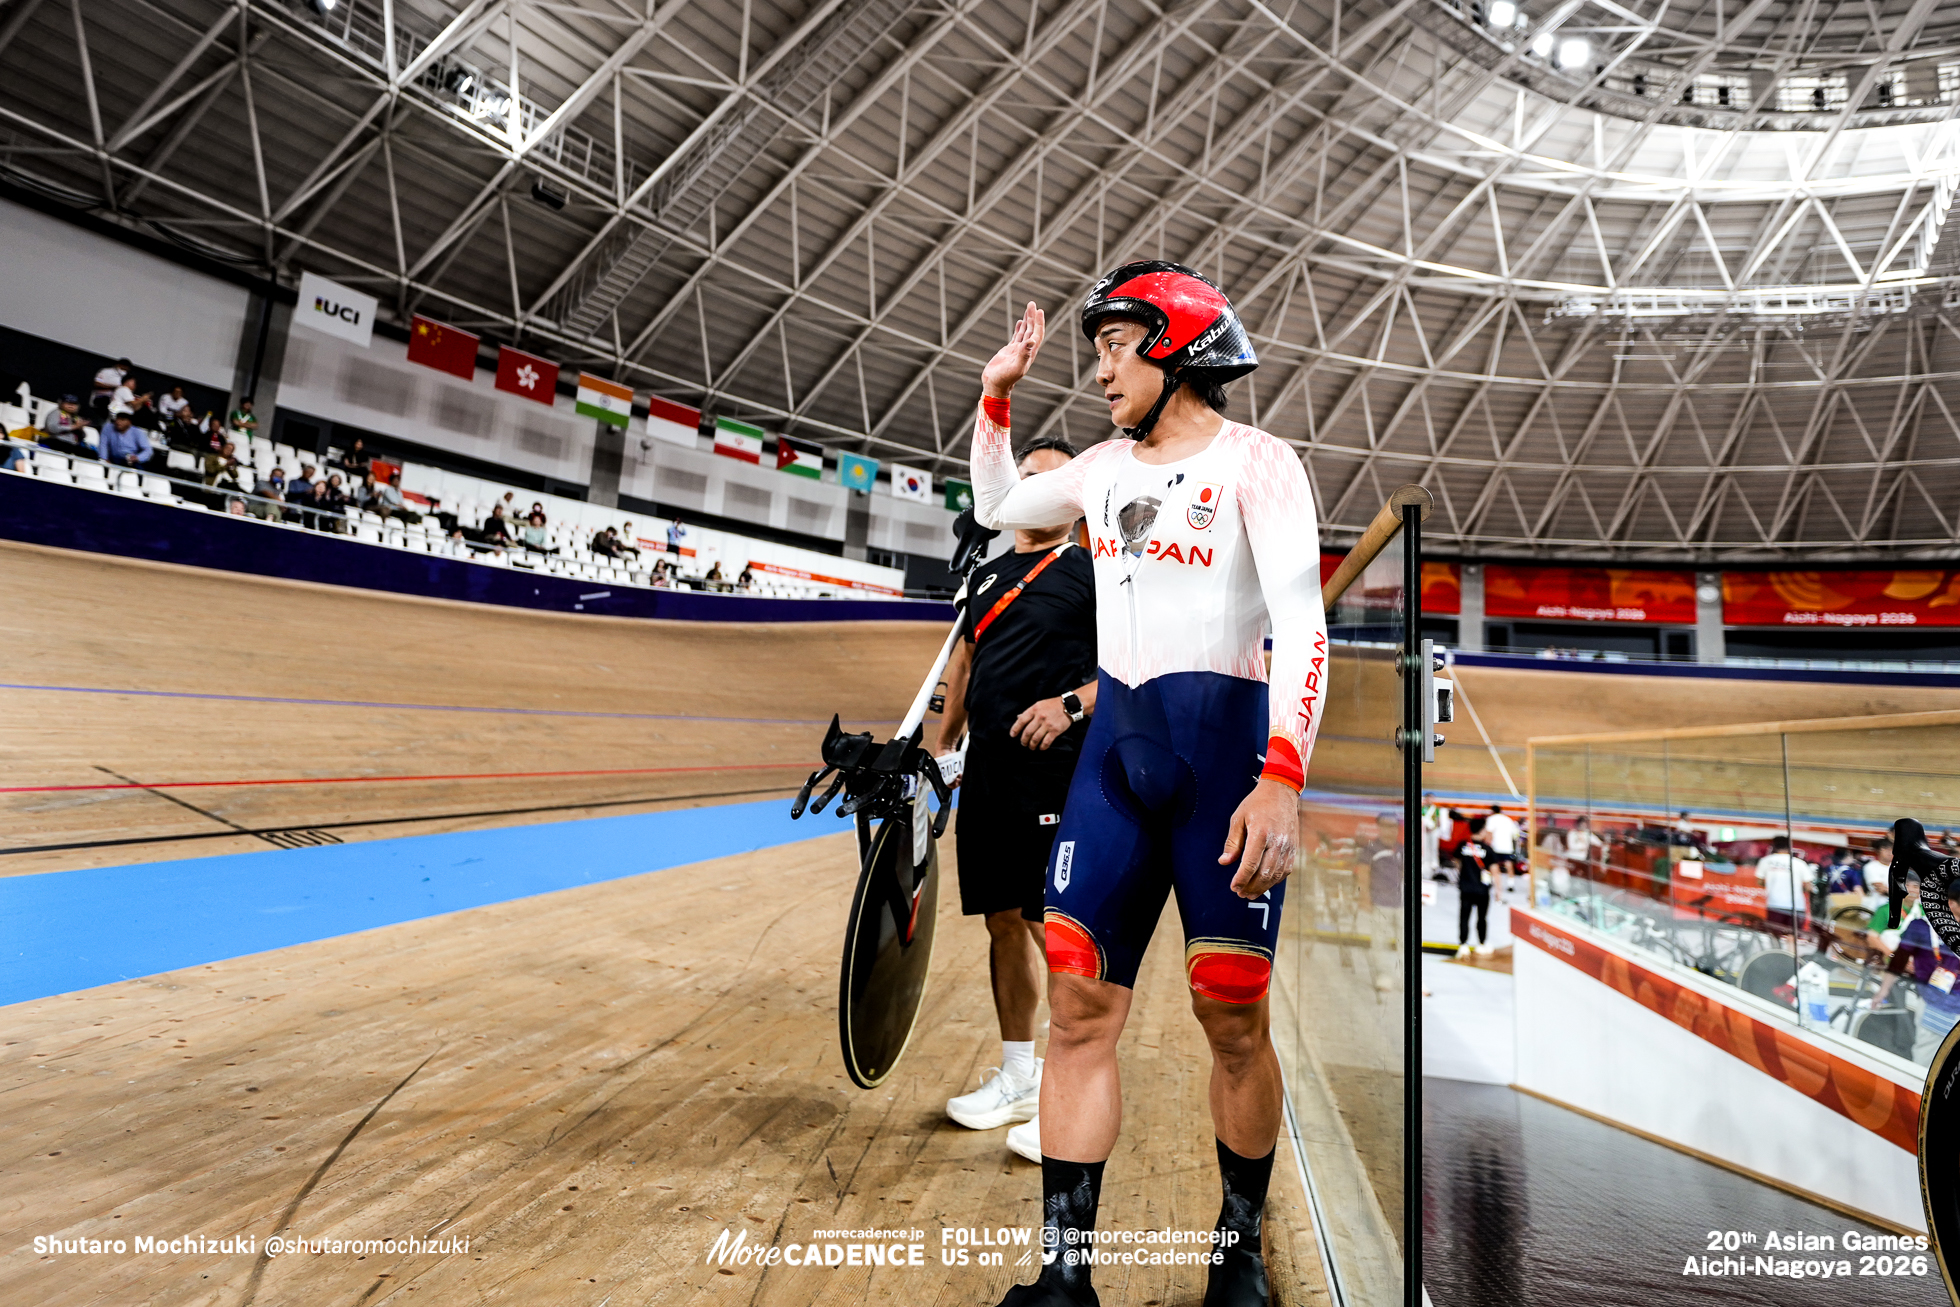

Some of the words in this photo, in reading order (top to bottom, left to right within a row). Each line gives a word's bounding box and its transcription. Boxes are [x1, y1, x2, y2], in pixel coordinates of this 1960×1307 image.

[323, 299, 360, 326] UCI
[1783, 611, 1878, 627] Aichi-Nagoya
[1879, 612, 1917, 625] 2026
[1298, 631, 1326, 733] JAPAN
[1061, 845, 1072, 882] Q36.5
[1943, 1060, 1960, 1100] DUR
